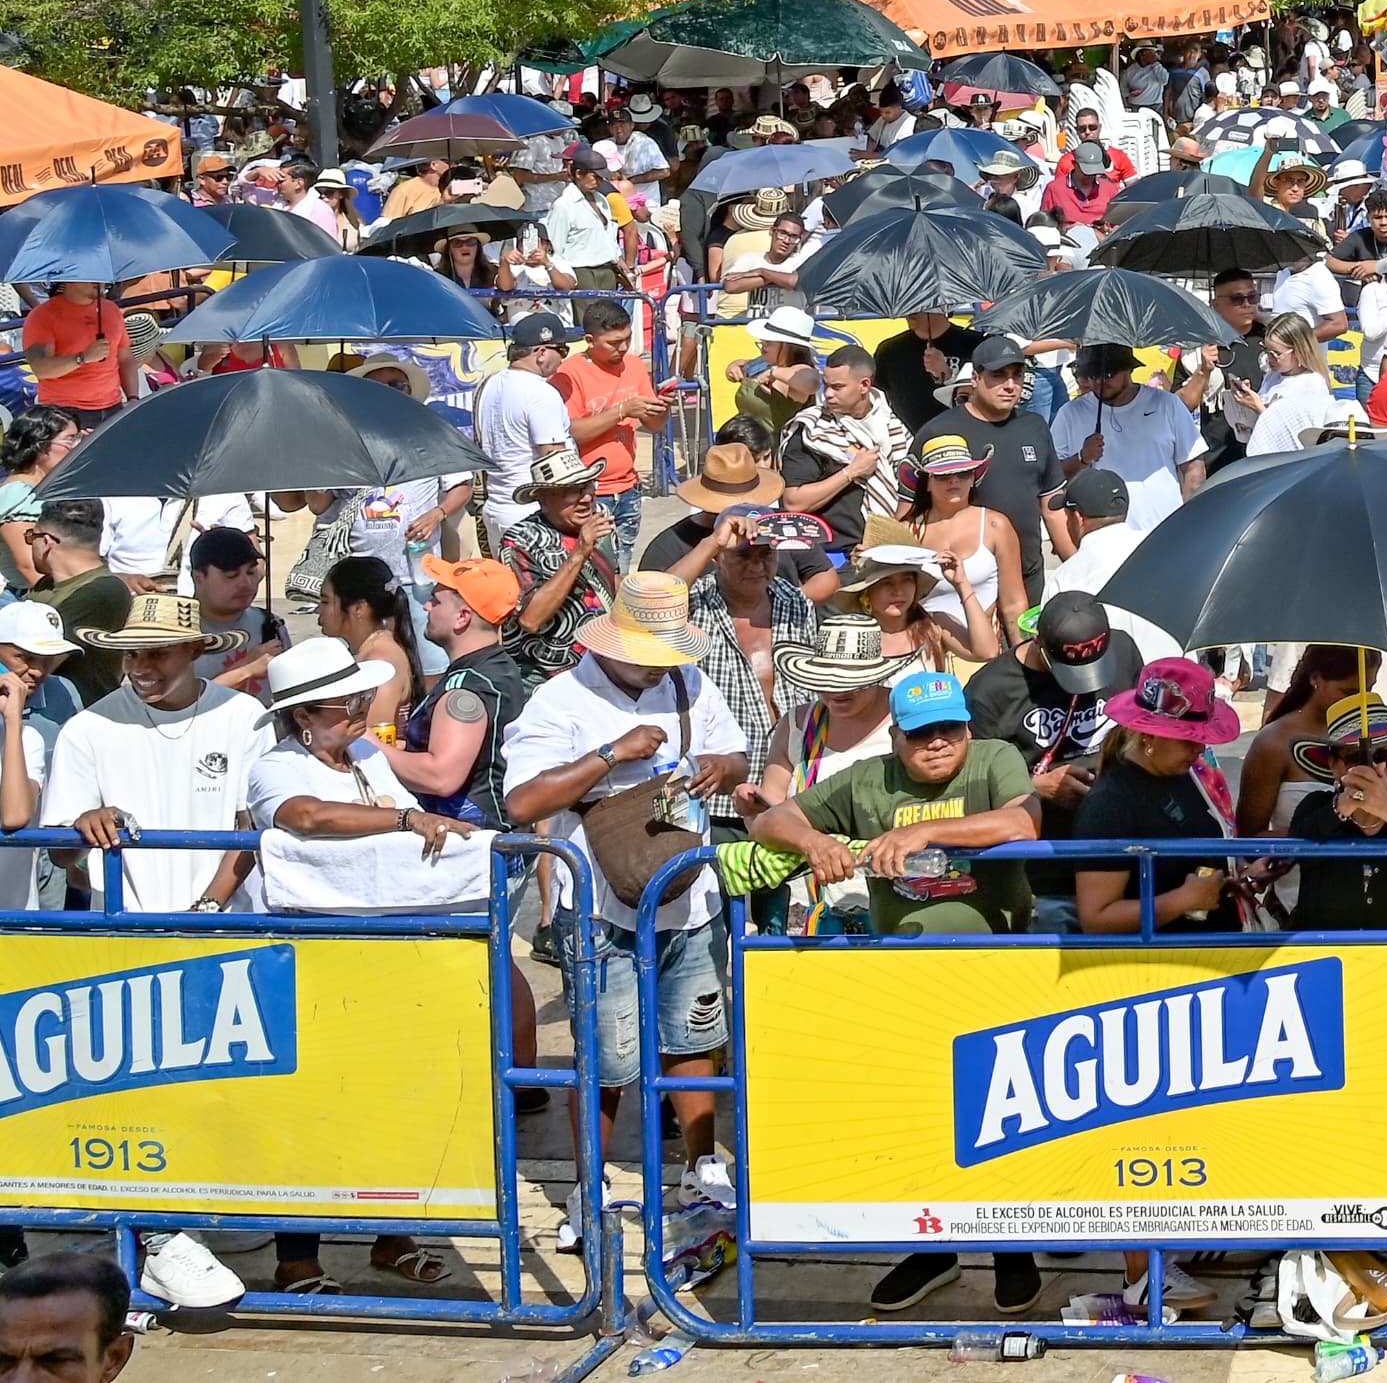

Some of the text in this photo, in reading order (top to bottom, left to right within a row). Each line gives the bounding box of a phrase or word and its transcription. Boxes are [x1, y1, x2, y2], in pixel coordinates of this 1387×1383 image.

[195, 785, 221, 793] AMIRI
[974, 972, 1323, 1149] AGUILA
[76, 1123, 157, 1134] FAMOSA DESDE
[69, 1137, 168, 1173] 1913
[1113, 1158, 1207, 1187] 1913
[976, 1205, 1287, 1219] EL EXCESO DE ALCOHOL ES PERJUDICIAL PARA LA SALUD.
[1333, 1204, 1363, 1214] VIVE
[950, 1219, 1313, 1234] PROHÍBESE EL EXPENDIO DE BEBIDAS EMBRIAGANTES A MENORES DE EDAD.
